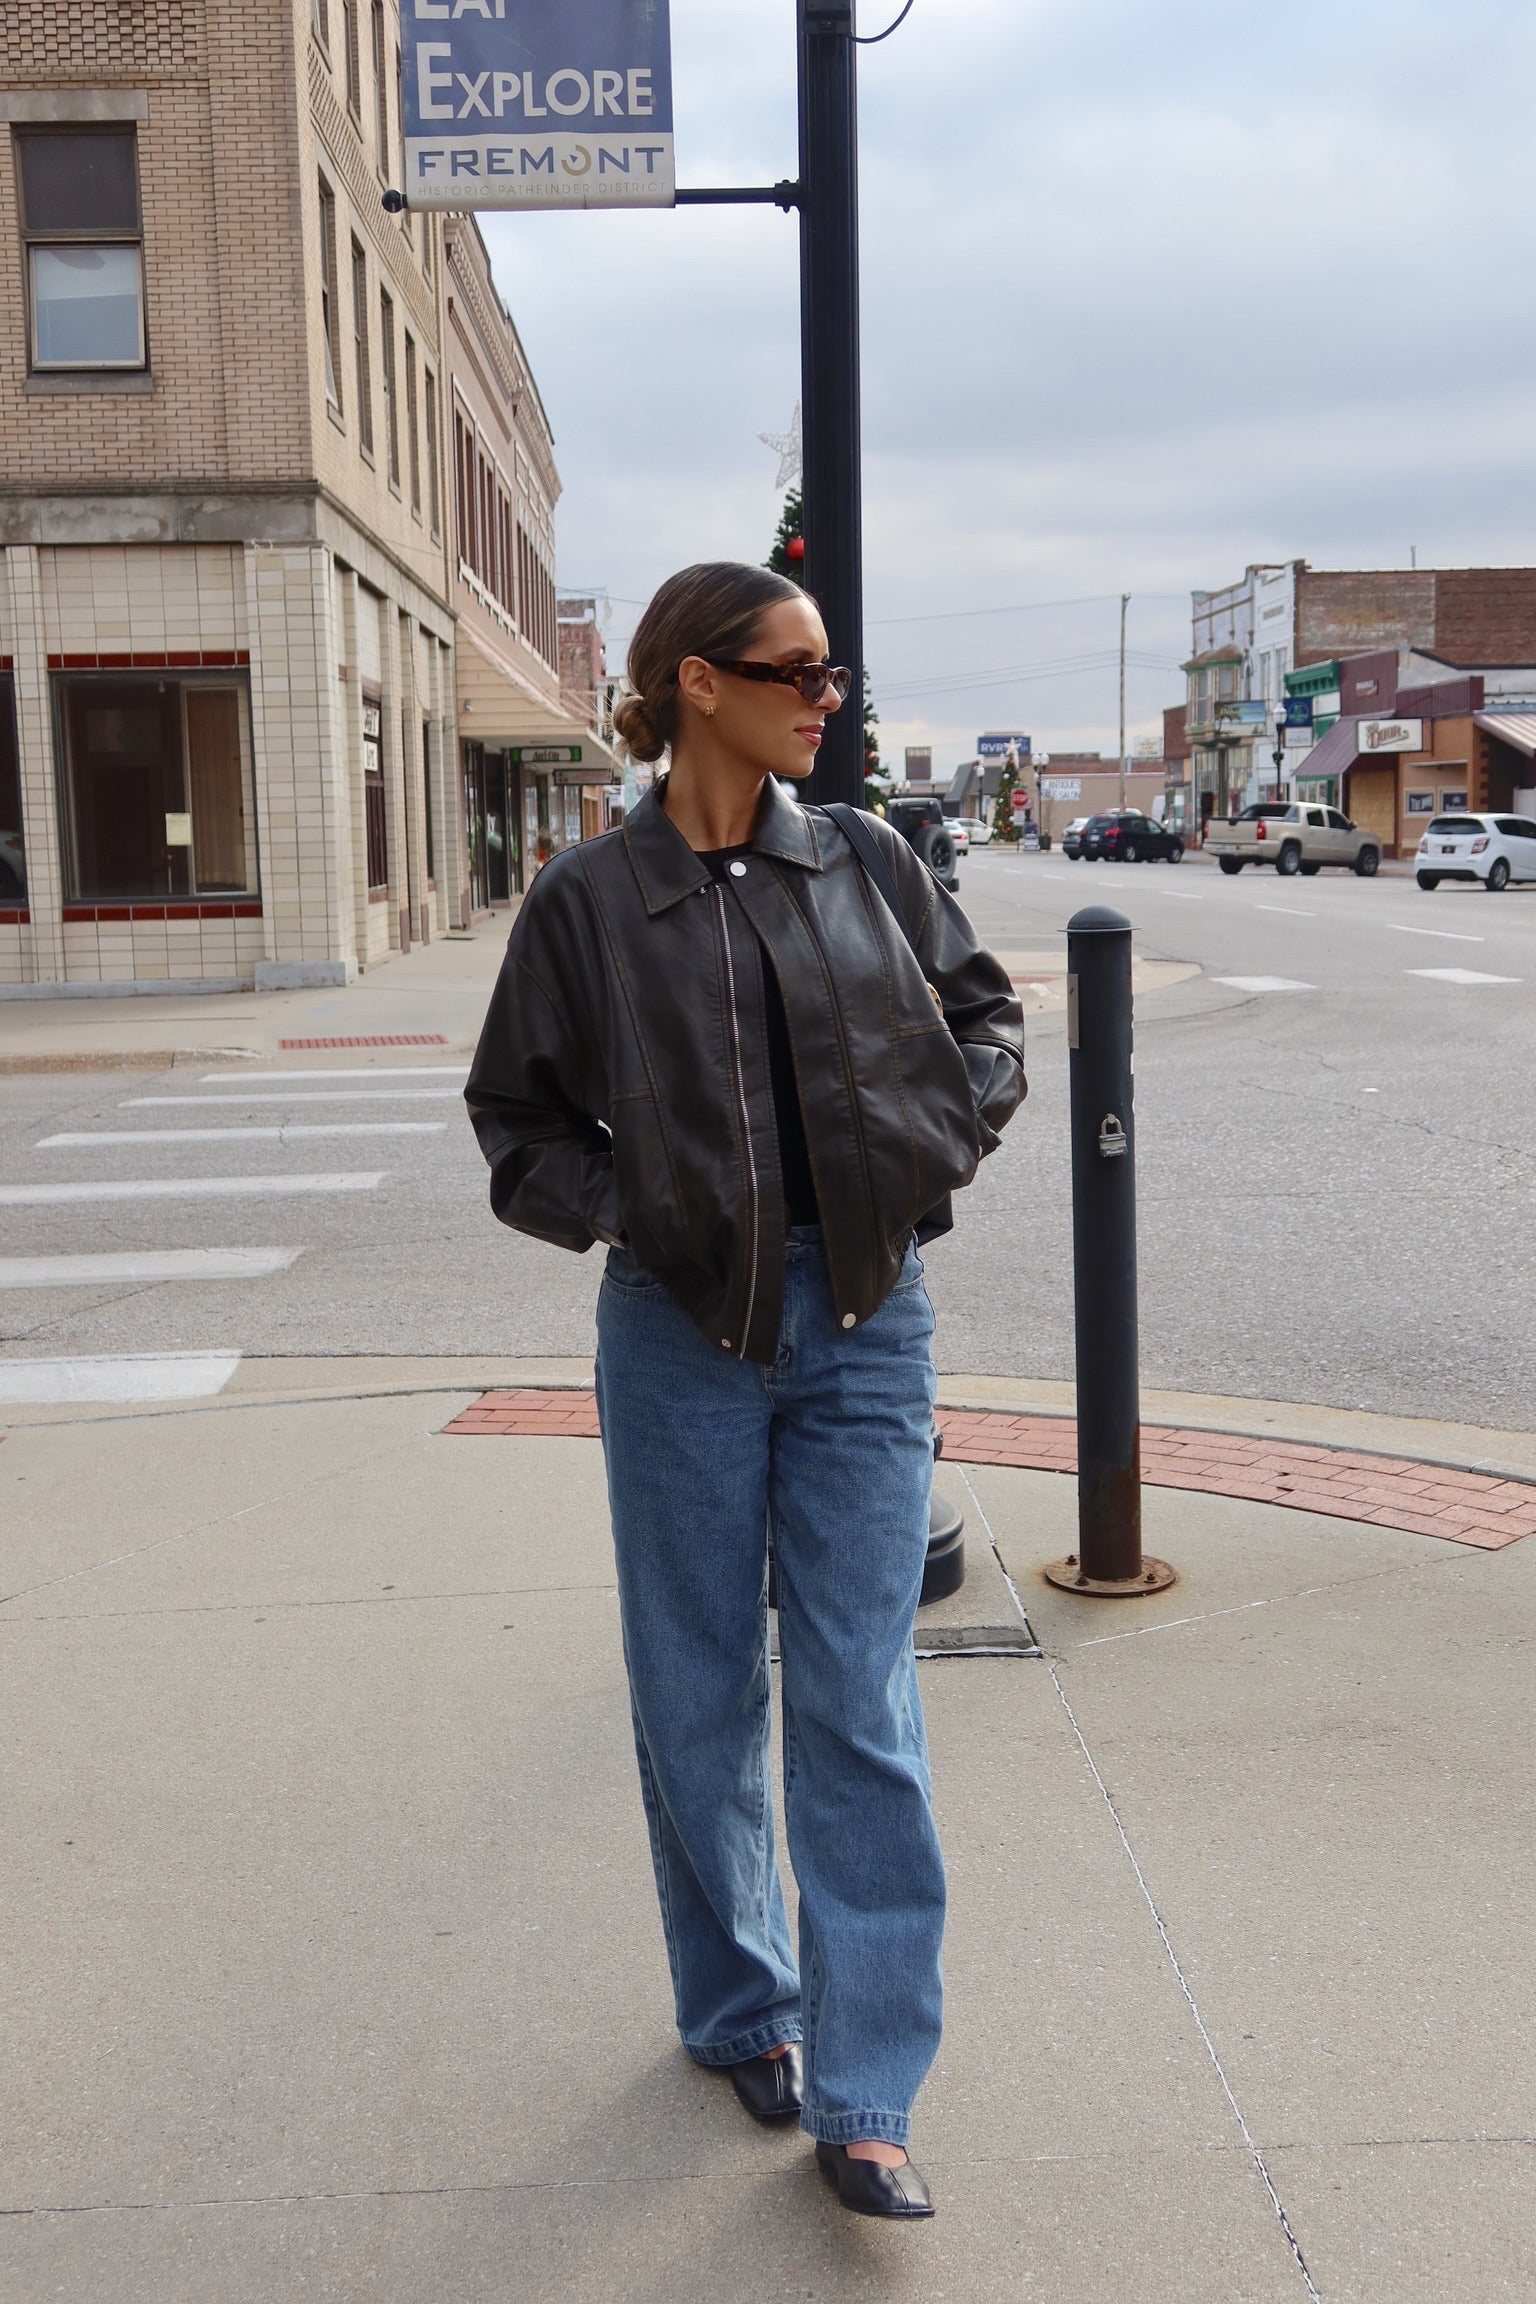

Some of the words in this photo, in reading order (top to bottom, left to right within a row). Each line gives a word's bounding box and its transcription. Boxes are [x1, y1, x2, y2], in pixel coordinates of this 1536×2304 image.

[416, 42, 653, 120] EXPLORE
[418, 145, 664, 177] FREMONT
[418, 185, 490, 197] HISTORIC
[498, 183, 591, 195] PATHFINDER
[599, 182, 665, 193] DISTRICT
[1012, 793, 1028, 802] STOP
